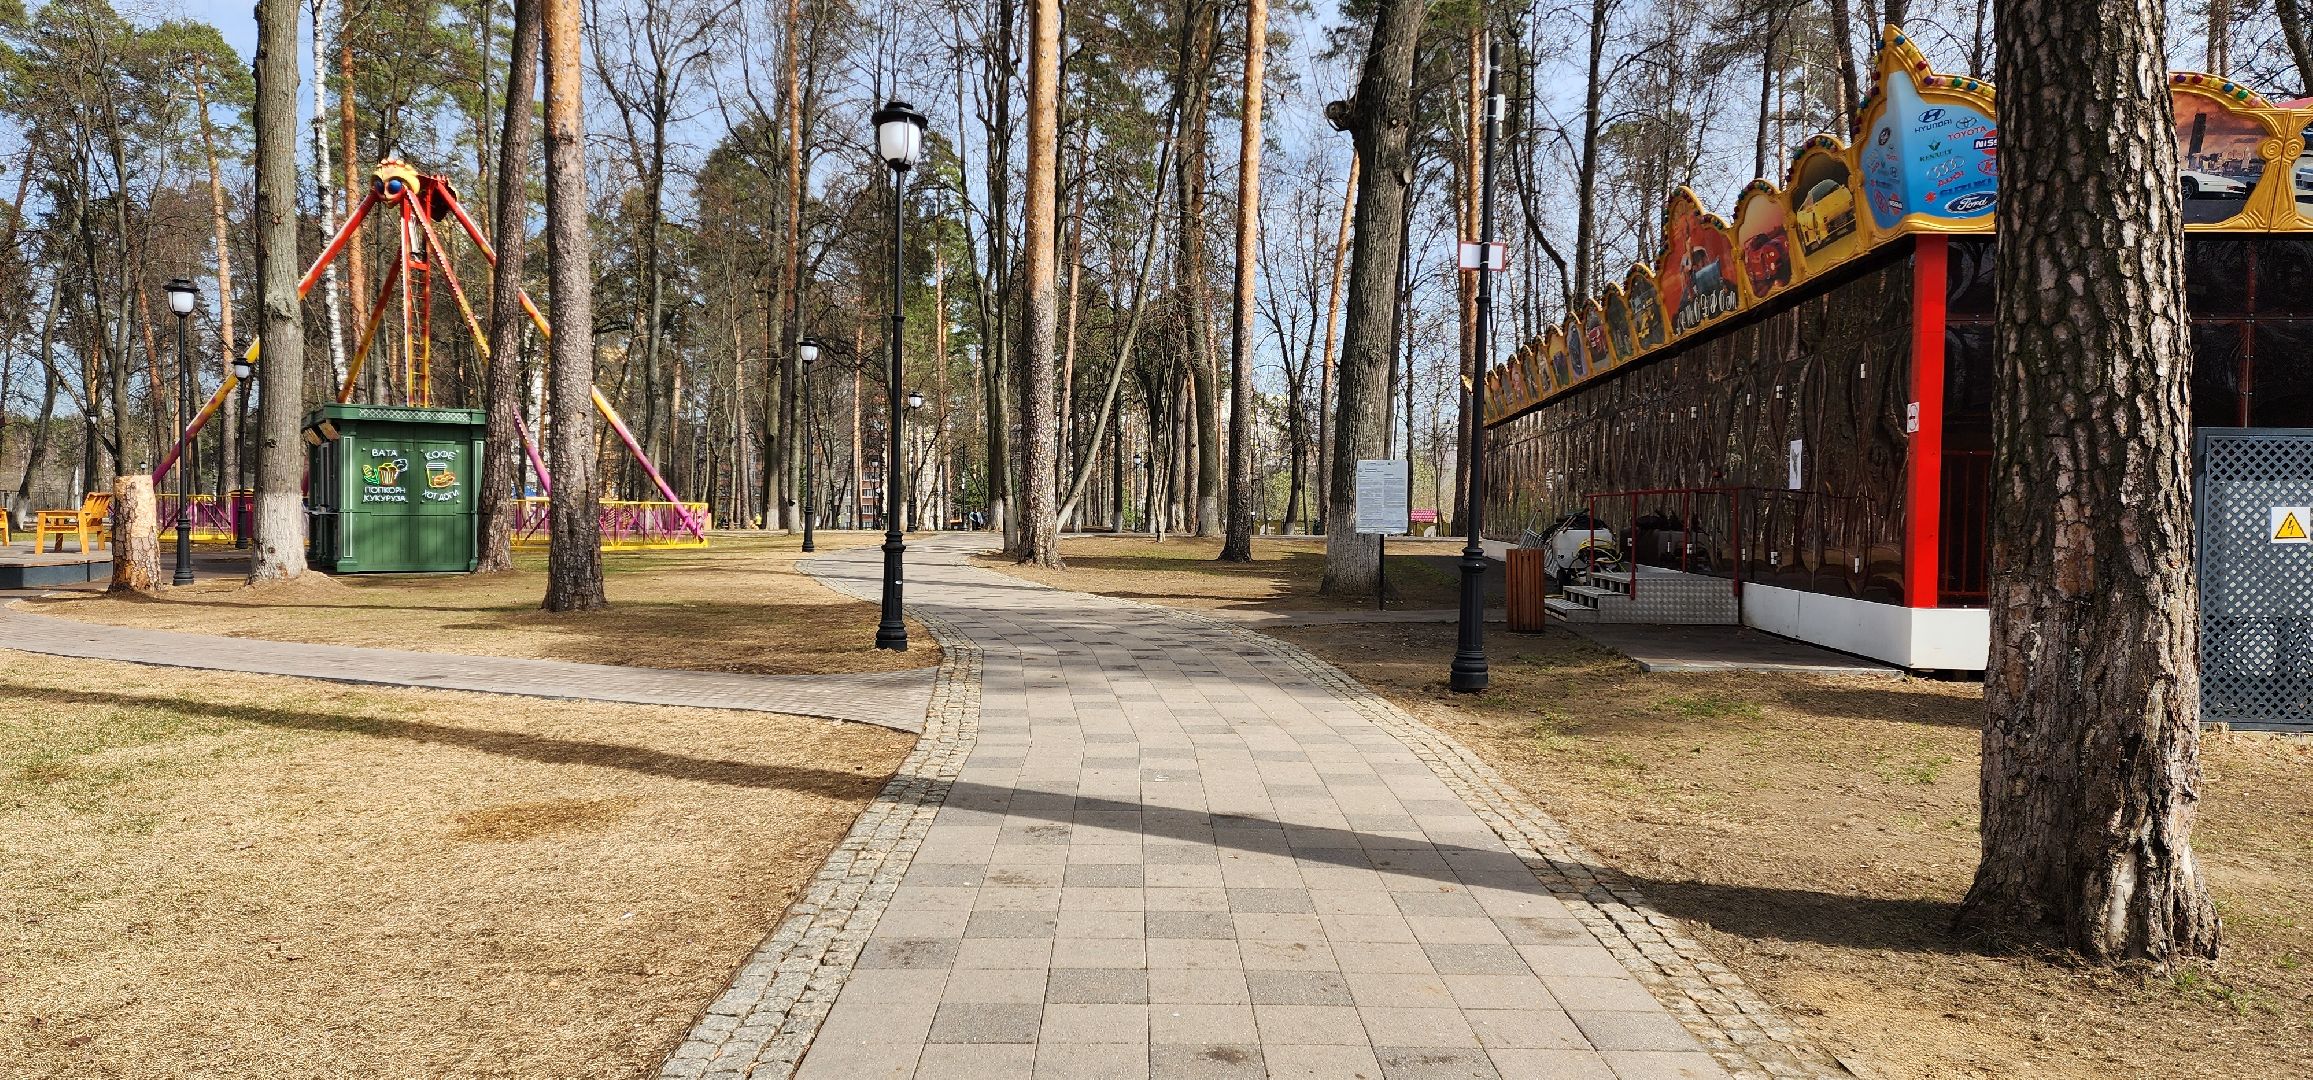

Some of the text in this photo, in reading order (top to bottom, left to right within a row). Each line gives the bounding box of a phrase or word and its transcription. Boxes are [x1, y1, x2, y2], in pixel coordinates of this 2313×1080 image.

[1914, 119, 1953, 133] HYUNDAI
[1947, 125, 1987, 141] TOYOTA
[1975, 139, 1998, 148] NISS
[1919, 149, 1953, 162] RENAULT
[1957, 196, 1988, 210] Ford
[371, 448, 398, 457] ВАТА
[424, 450, 457, 461] КОФЕ
[364, 486, 406, 494] ПОПКОРН
[421, 489, 460, 501] ХОТ ДОГИ
[363, 494, 406, 502] КУКУРУЗА
